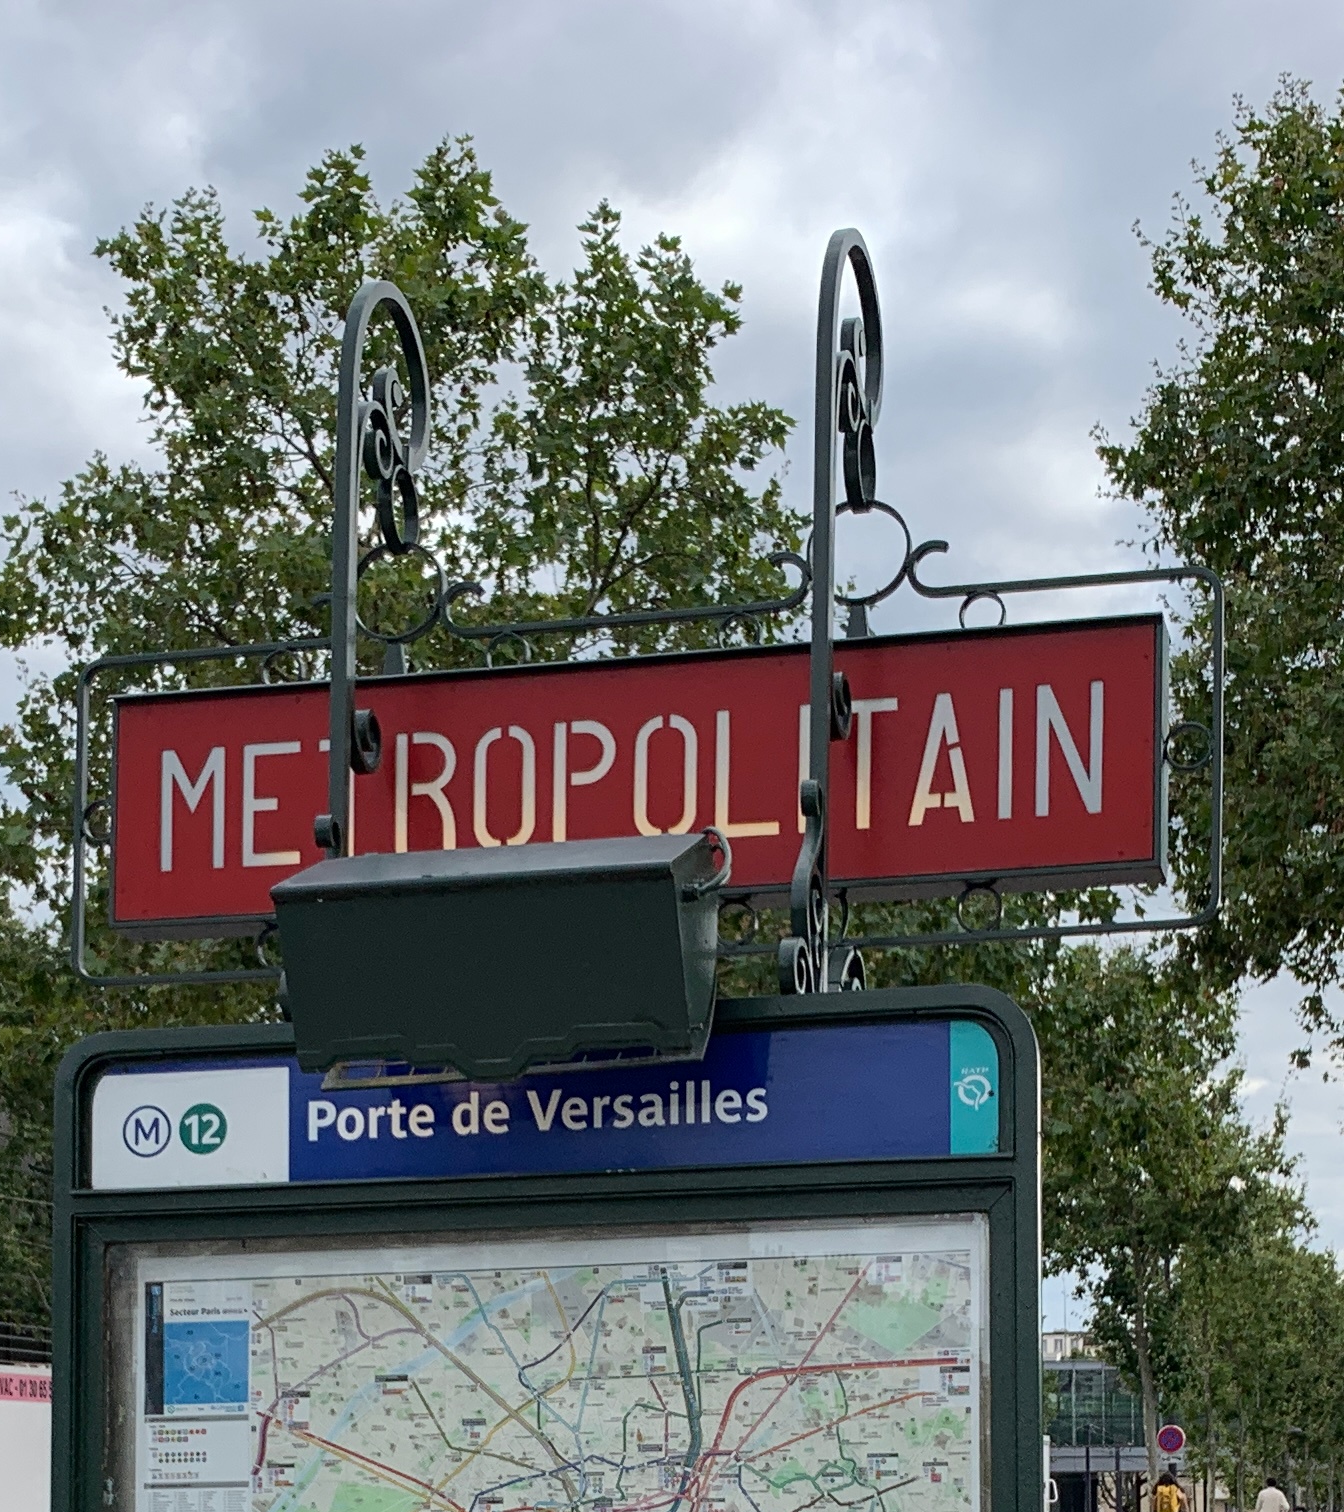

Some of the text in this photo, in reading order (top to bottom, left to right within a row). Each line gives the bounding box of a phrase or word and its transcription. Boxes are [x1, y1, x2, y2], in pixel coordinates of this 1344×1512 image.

[160, 678, 1104, 872] MEROPOLITAIN
[307, 1080, 769, 1142] Porte de Versailles
[184, 1114, 223, 1144] 12
[201, 1307, 221, 1315] Paris
[0, 1377, 13, 1396] VAC
